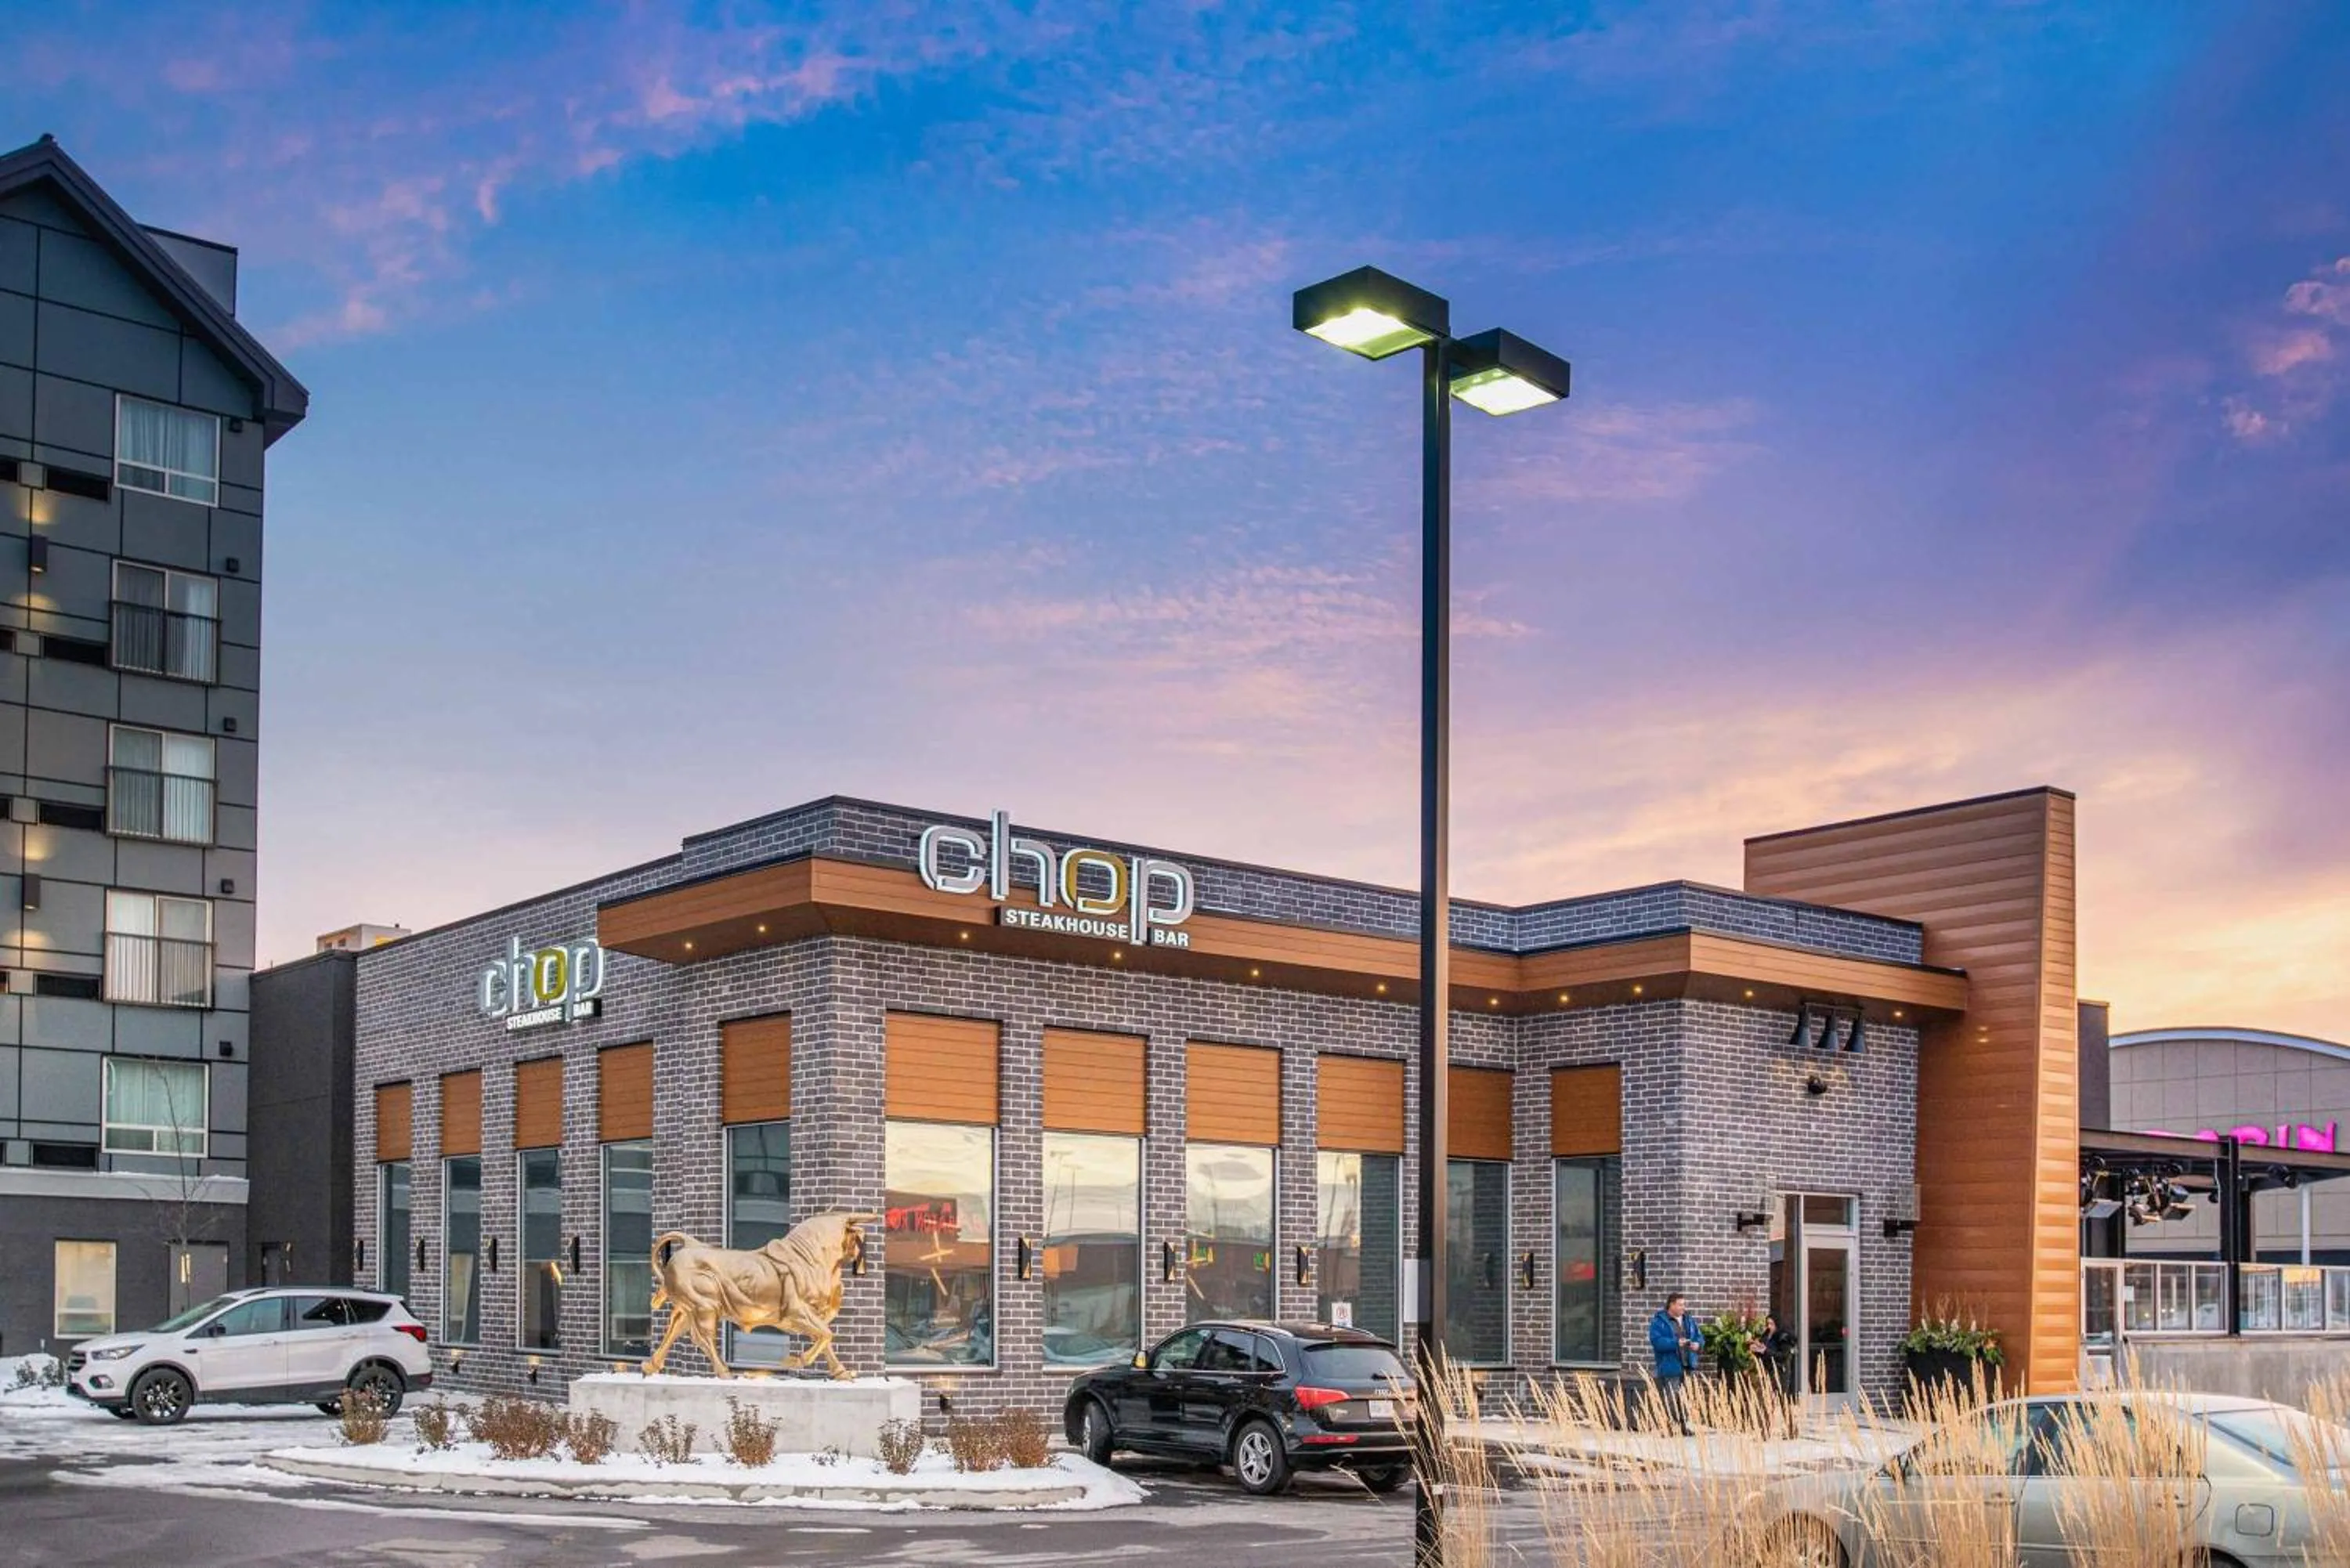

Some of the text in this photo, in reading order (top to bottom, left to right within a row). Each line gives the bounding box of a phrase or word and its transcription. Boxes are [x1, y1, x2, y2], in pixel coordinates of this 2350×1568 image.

[919, 808, 1195, 946] chop
[1005, 909, 1189, 947] STEAKHOUSE BAR
[477, 937, 604, 1022] chop
[507, 1006, 562, 1030] STEAKHOUSE
